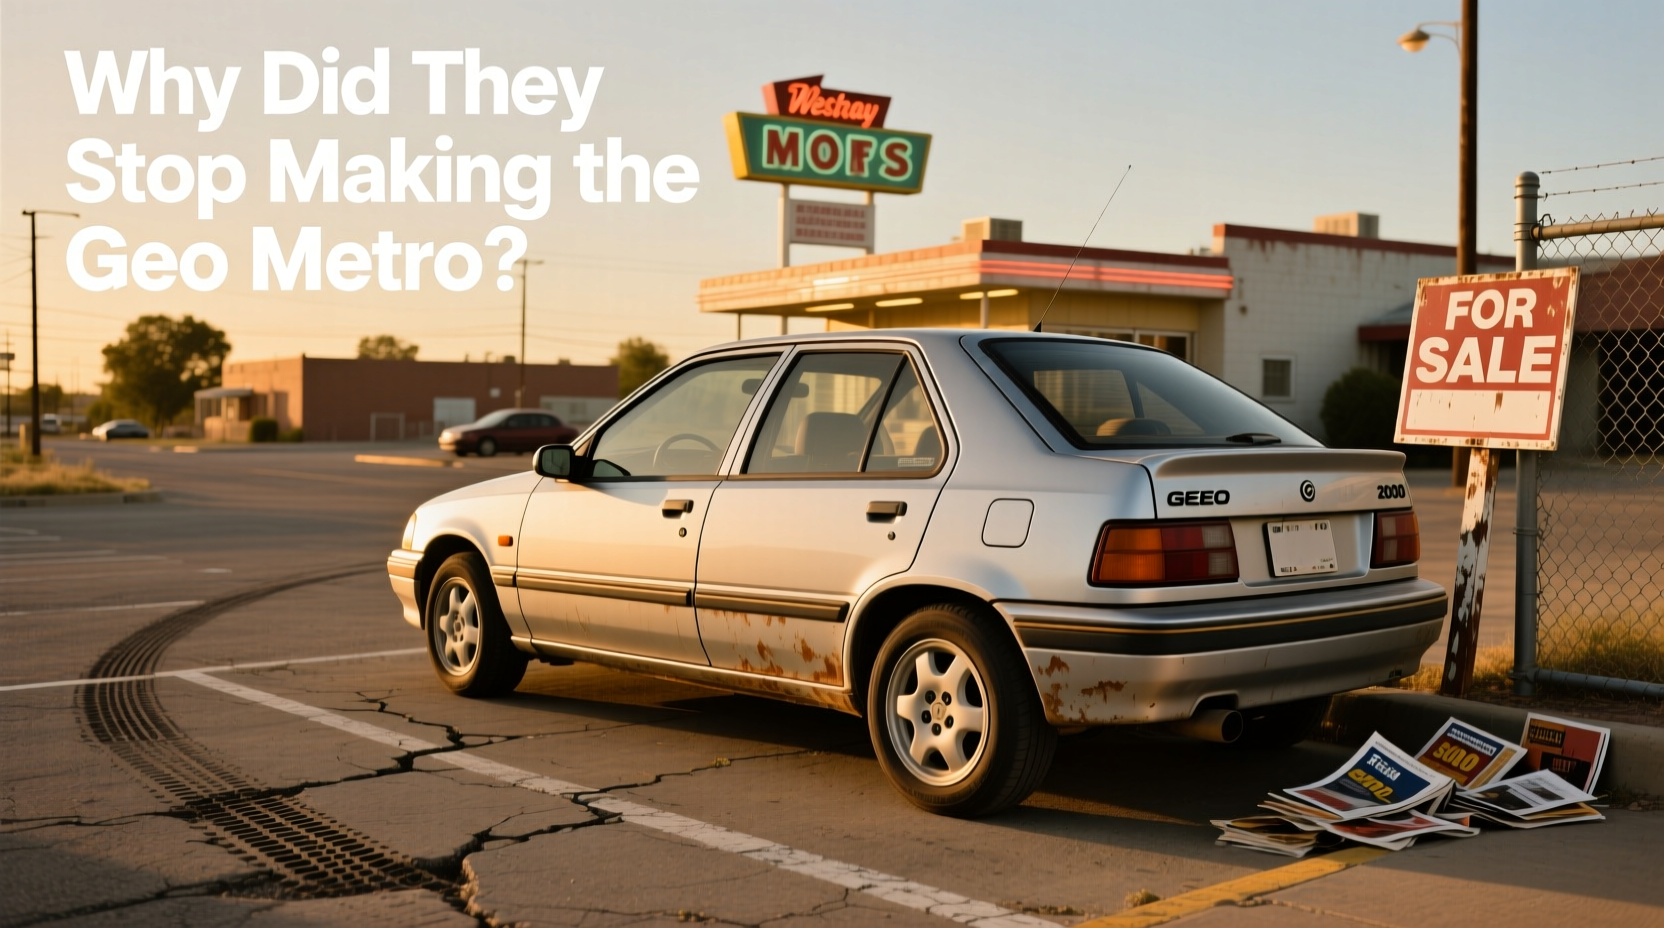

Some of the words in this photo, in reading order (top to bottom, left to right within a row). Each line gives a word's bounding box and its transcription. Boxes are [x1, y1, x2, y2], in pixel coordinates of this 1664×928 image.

[762, 123, 914, 183] MOFS
[1444, 287, 1538, 331] FOR
[1415, 334, 1557, 385] SALE
[1167, 489, 1231, 507] GEEO
[1377, 484, 1406, 500] 2000
